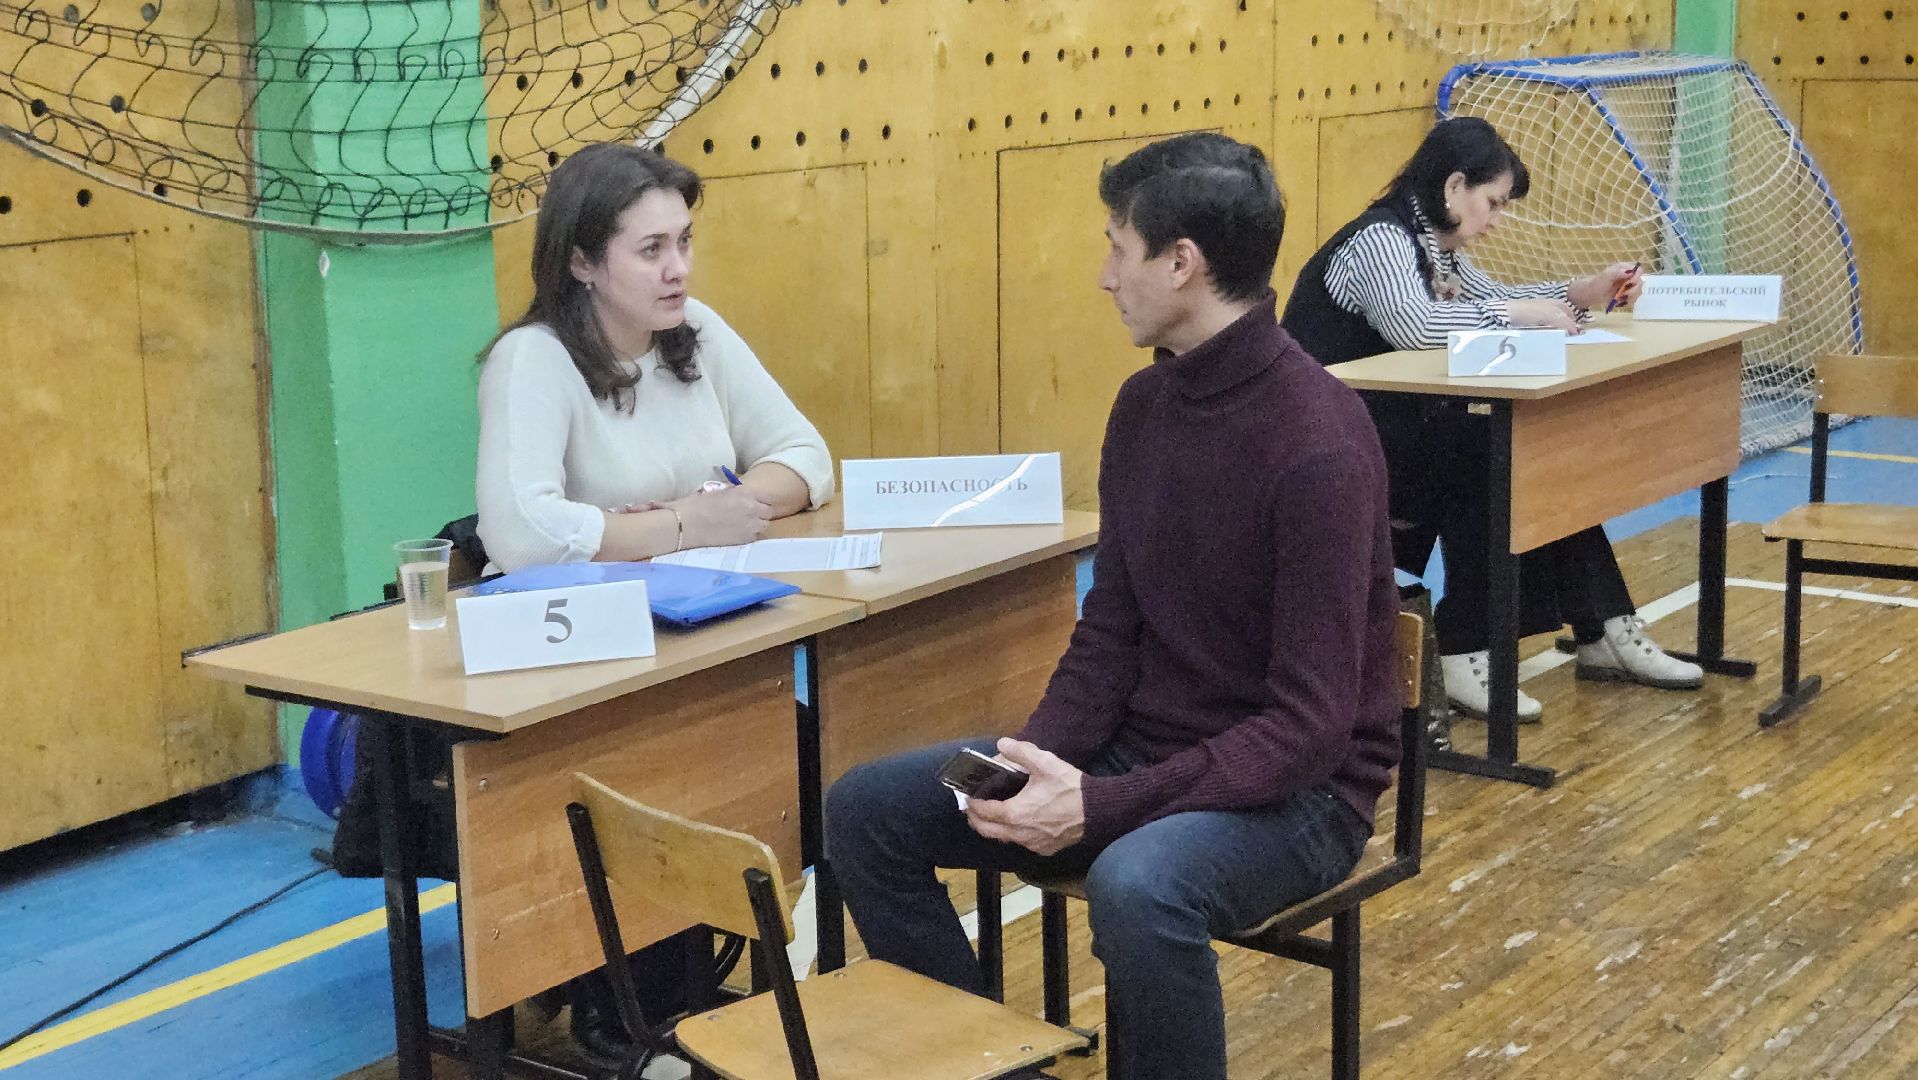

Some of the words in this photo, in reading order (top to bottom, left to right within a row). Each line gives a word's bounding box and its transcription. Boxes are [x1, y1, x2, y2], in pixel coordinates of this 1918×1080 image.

[1684, 299, 1727, 308] РЫНОК
[1498, 335, 1517, 360] 6
[544, 598, 573, 644] 5
